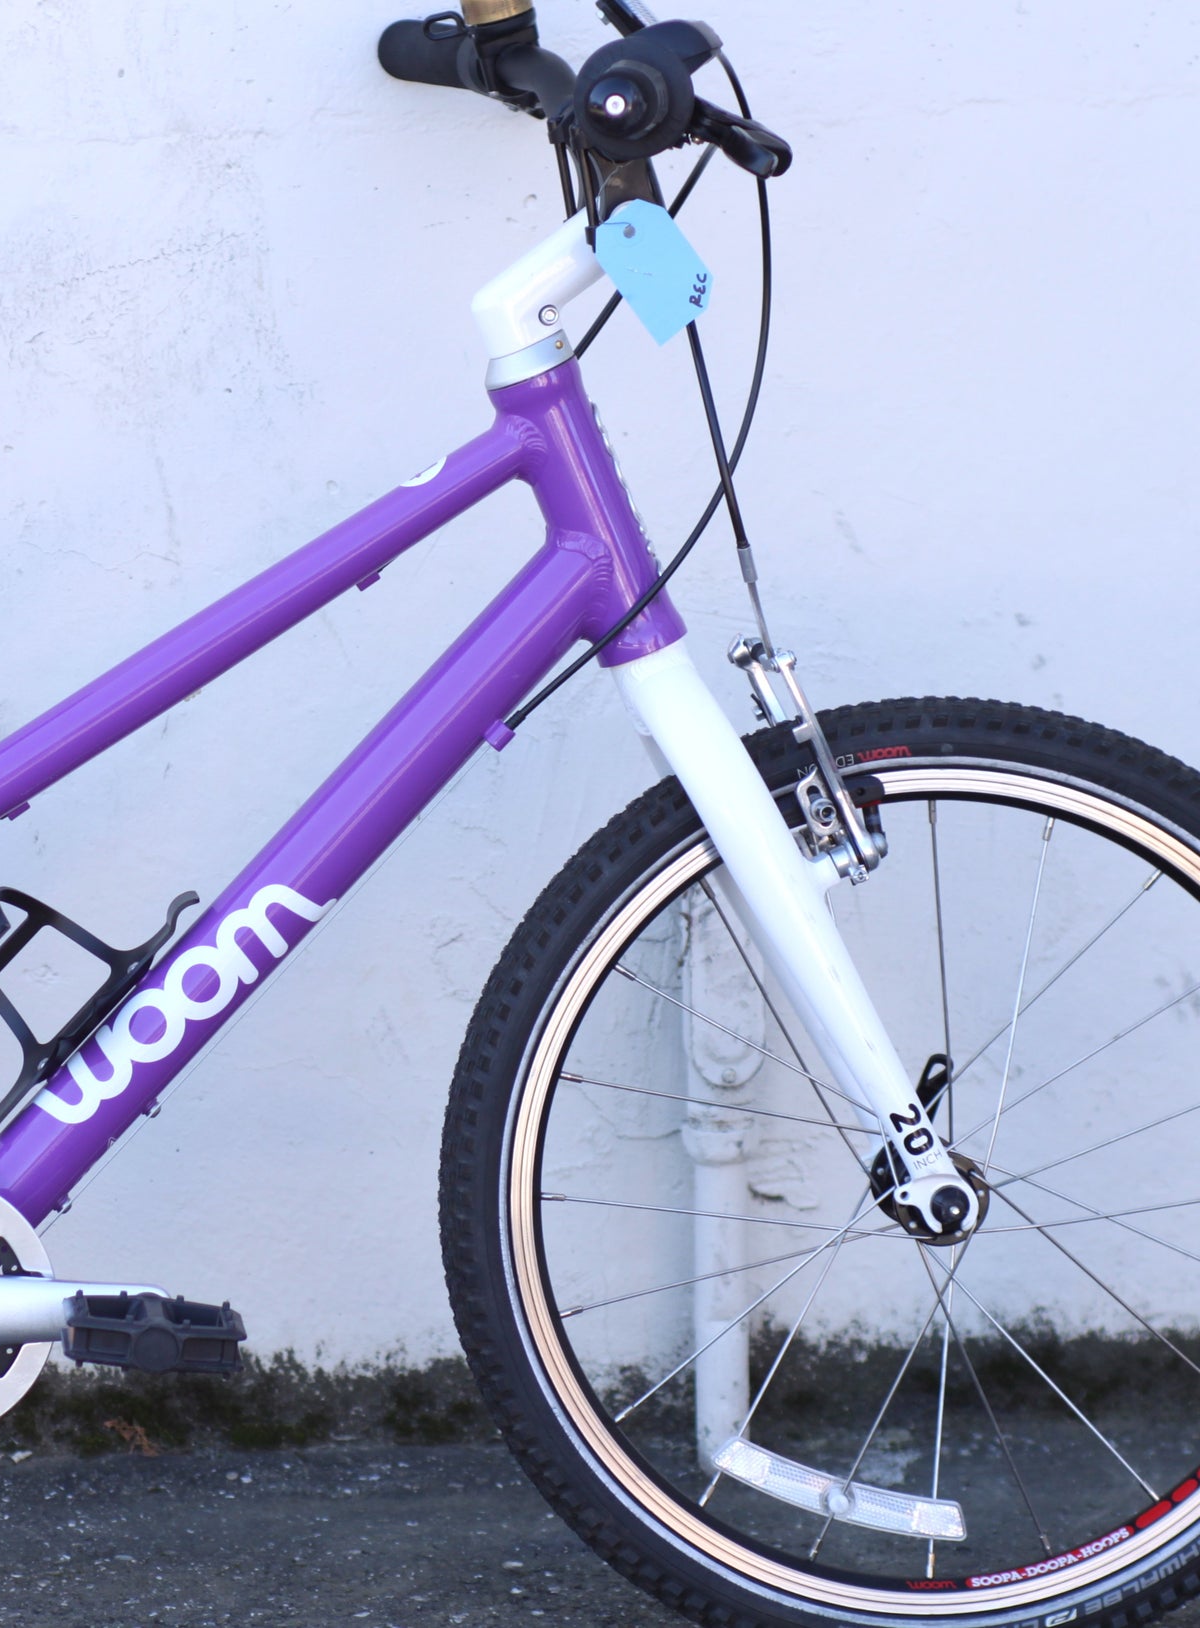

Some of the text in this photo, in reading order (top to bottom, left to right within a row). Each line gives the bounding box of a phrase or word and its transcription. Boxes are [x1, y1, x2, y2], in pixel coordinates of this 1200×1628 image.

[689, 273, 707, 308] REC
[857, 745, 912, 763] woom
[32, 883, 338, 1125] woom
[889, 1103, 934, 1156] 20
[912, 1149, 943, 1170] INCH
[905, 1527, 1130, 1590] woom SOOPA-DOOPA-HOOPS
[1083, 1539, 1200, 1616] HWALBE
